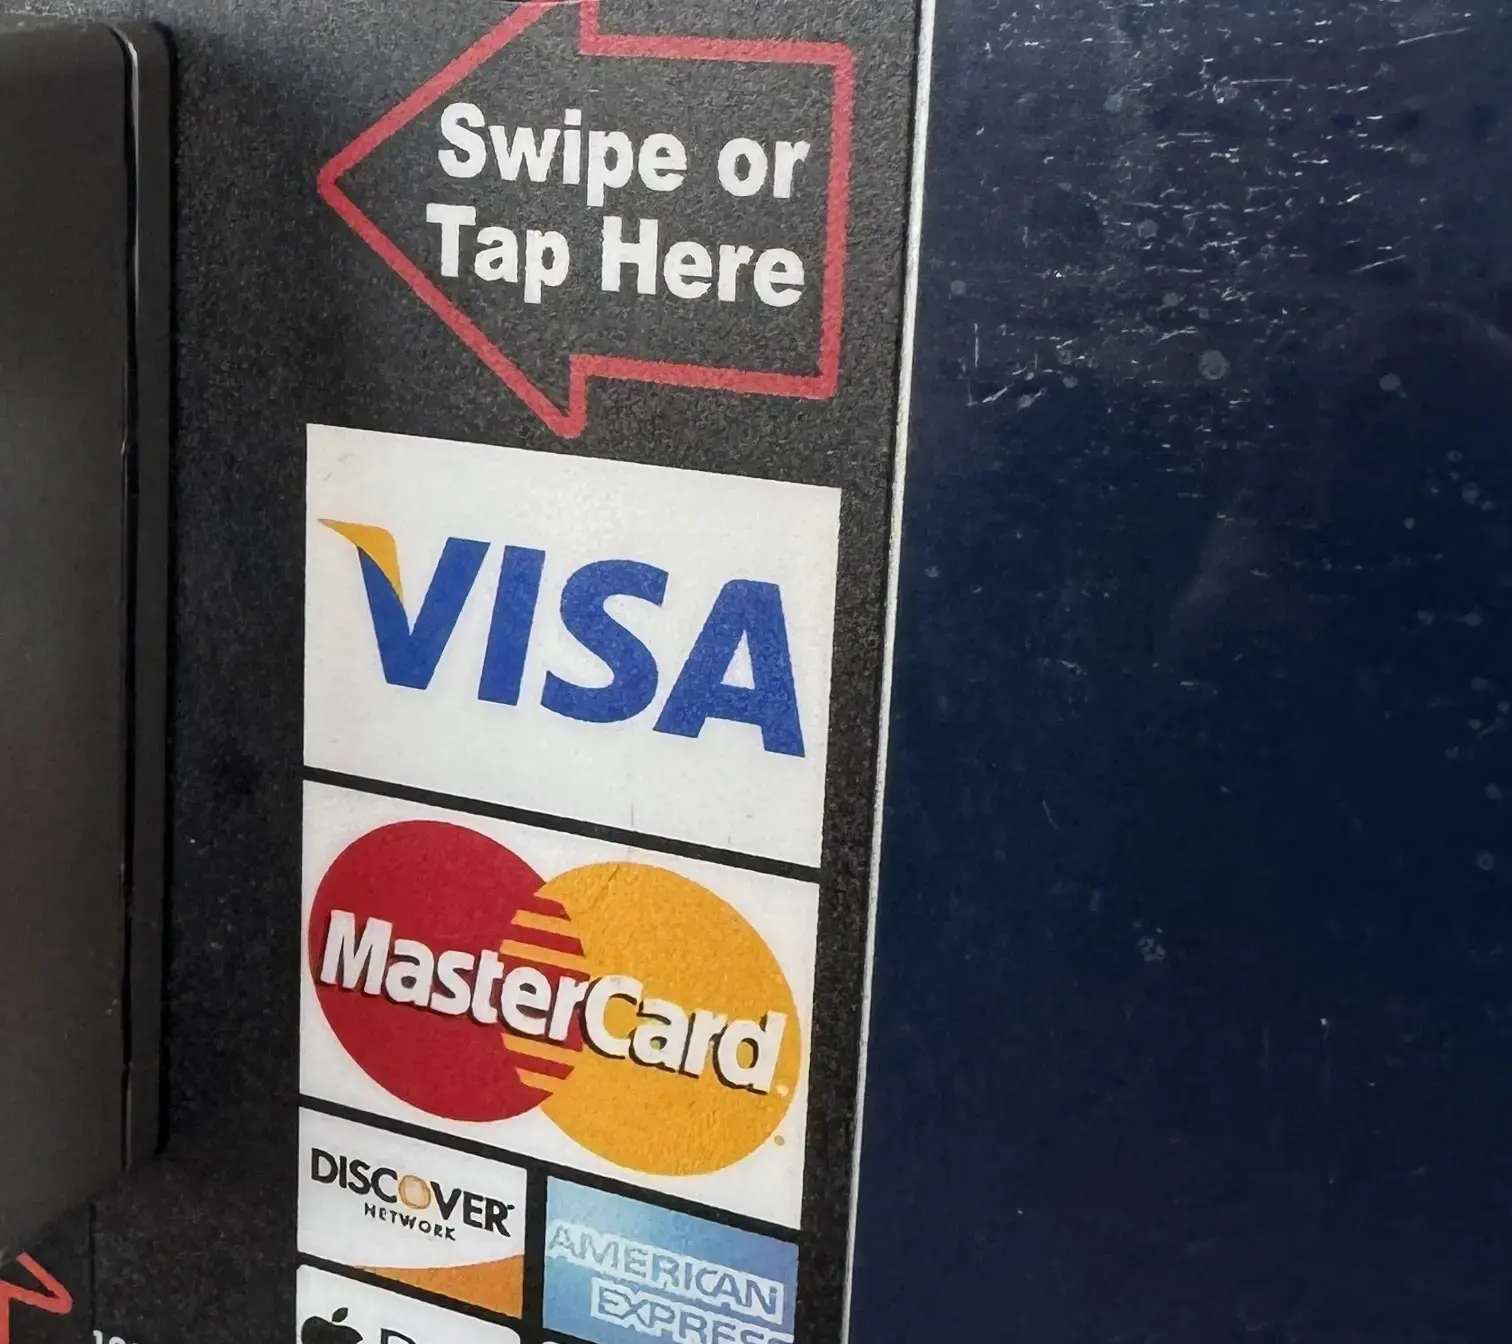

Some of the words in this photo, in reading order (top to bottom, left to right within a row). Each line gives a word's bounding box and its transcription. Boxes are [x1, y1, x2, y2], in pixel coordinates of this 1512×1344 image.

[437, 101, 688, 208] Swipe
[717, 137, 811, 199] or
[426, 202, 570, 304] Tap
[600, 215, 806, 308] Here
[318, 517, 806, 757] VISA
[320, 908, 788, 1096] MasterCard
[309, 1146, 515, 1238] DISCOVER
[363, 1202, 457, 1241] NETWORK
[549, 1223, 781, 1316] AMERICAN
